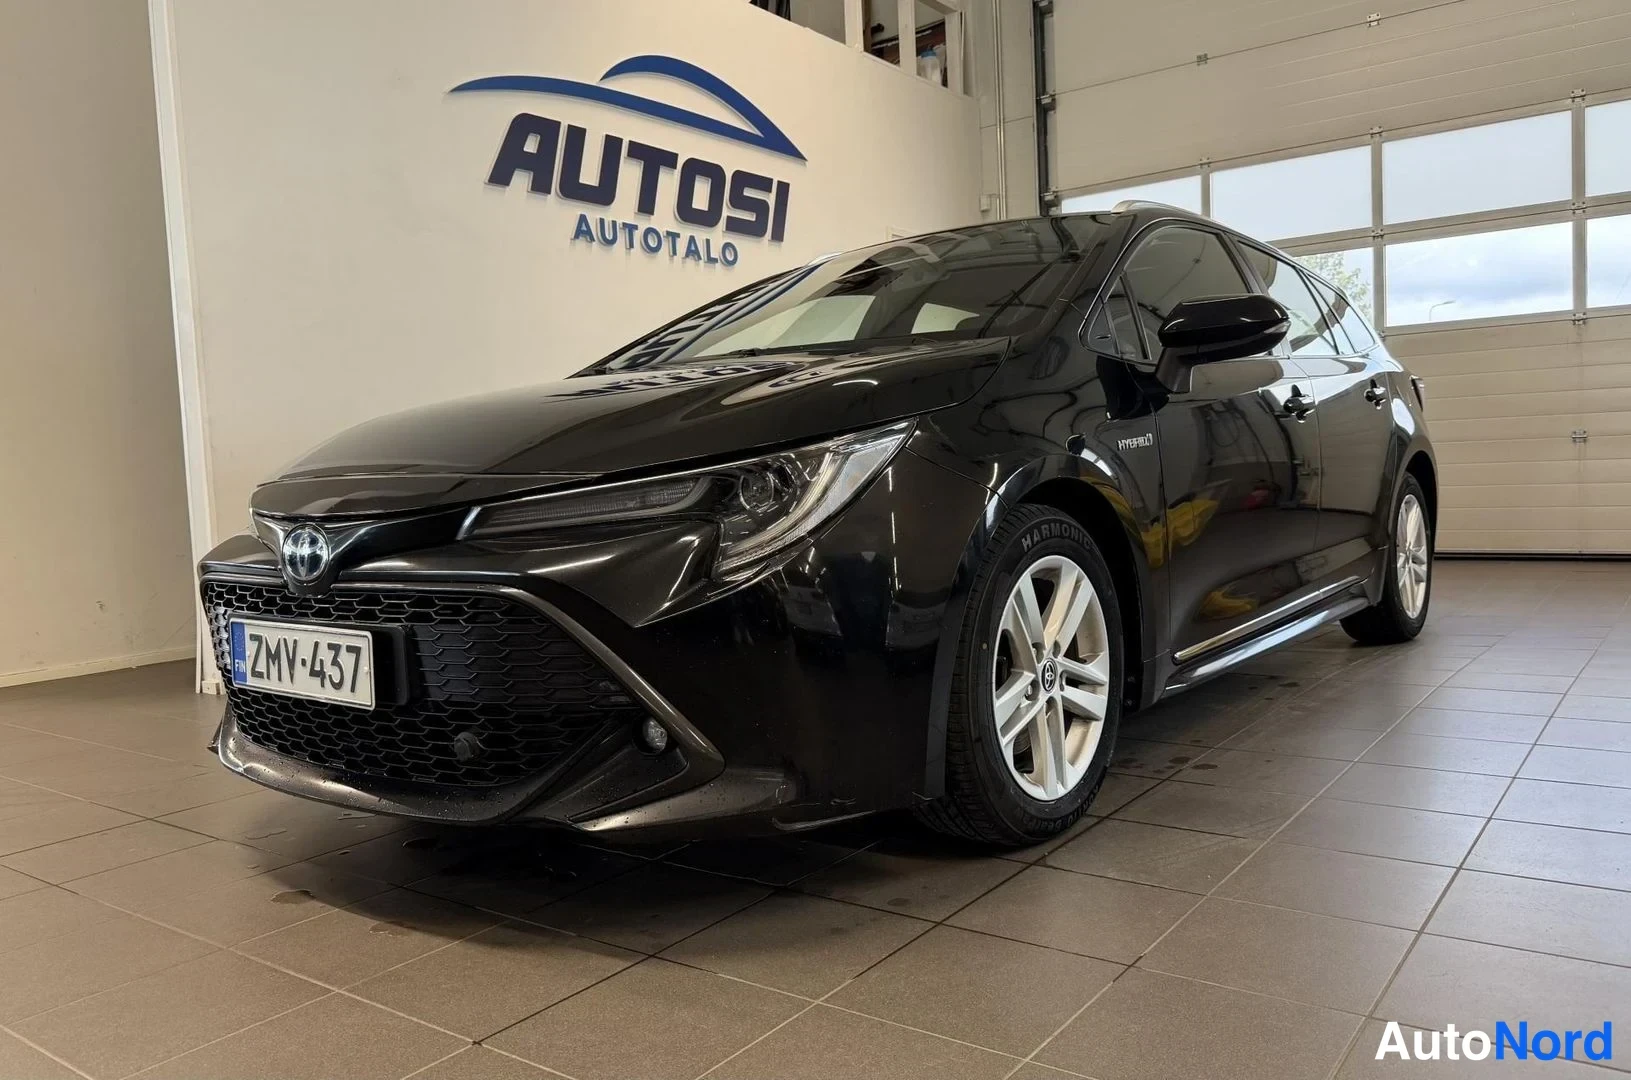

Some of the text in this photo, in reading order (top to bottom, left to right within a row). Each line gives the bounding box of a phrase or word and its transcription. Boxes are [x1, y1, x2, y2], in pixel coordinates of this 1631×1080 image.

[486, 112, 791, 242] AUTOSI
[572, 213, 739, 266] AUTOTALO
[1118, 436, 1148, 450] HYBRID
[1021, 522, 1092, 552] HARMONIC
[235, 659, 246, 673] FIN
[249, 633, 362, 693] ZMV-437
